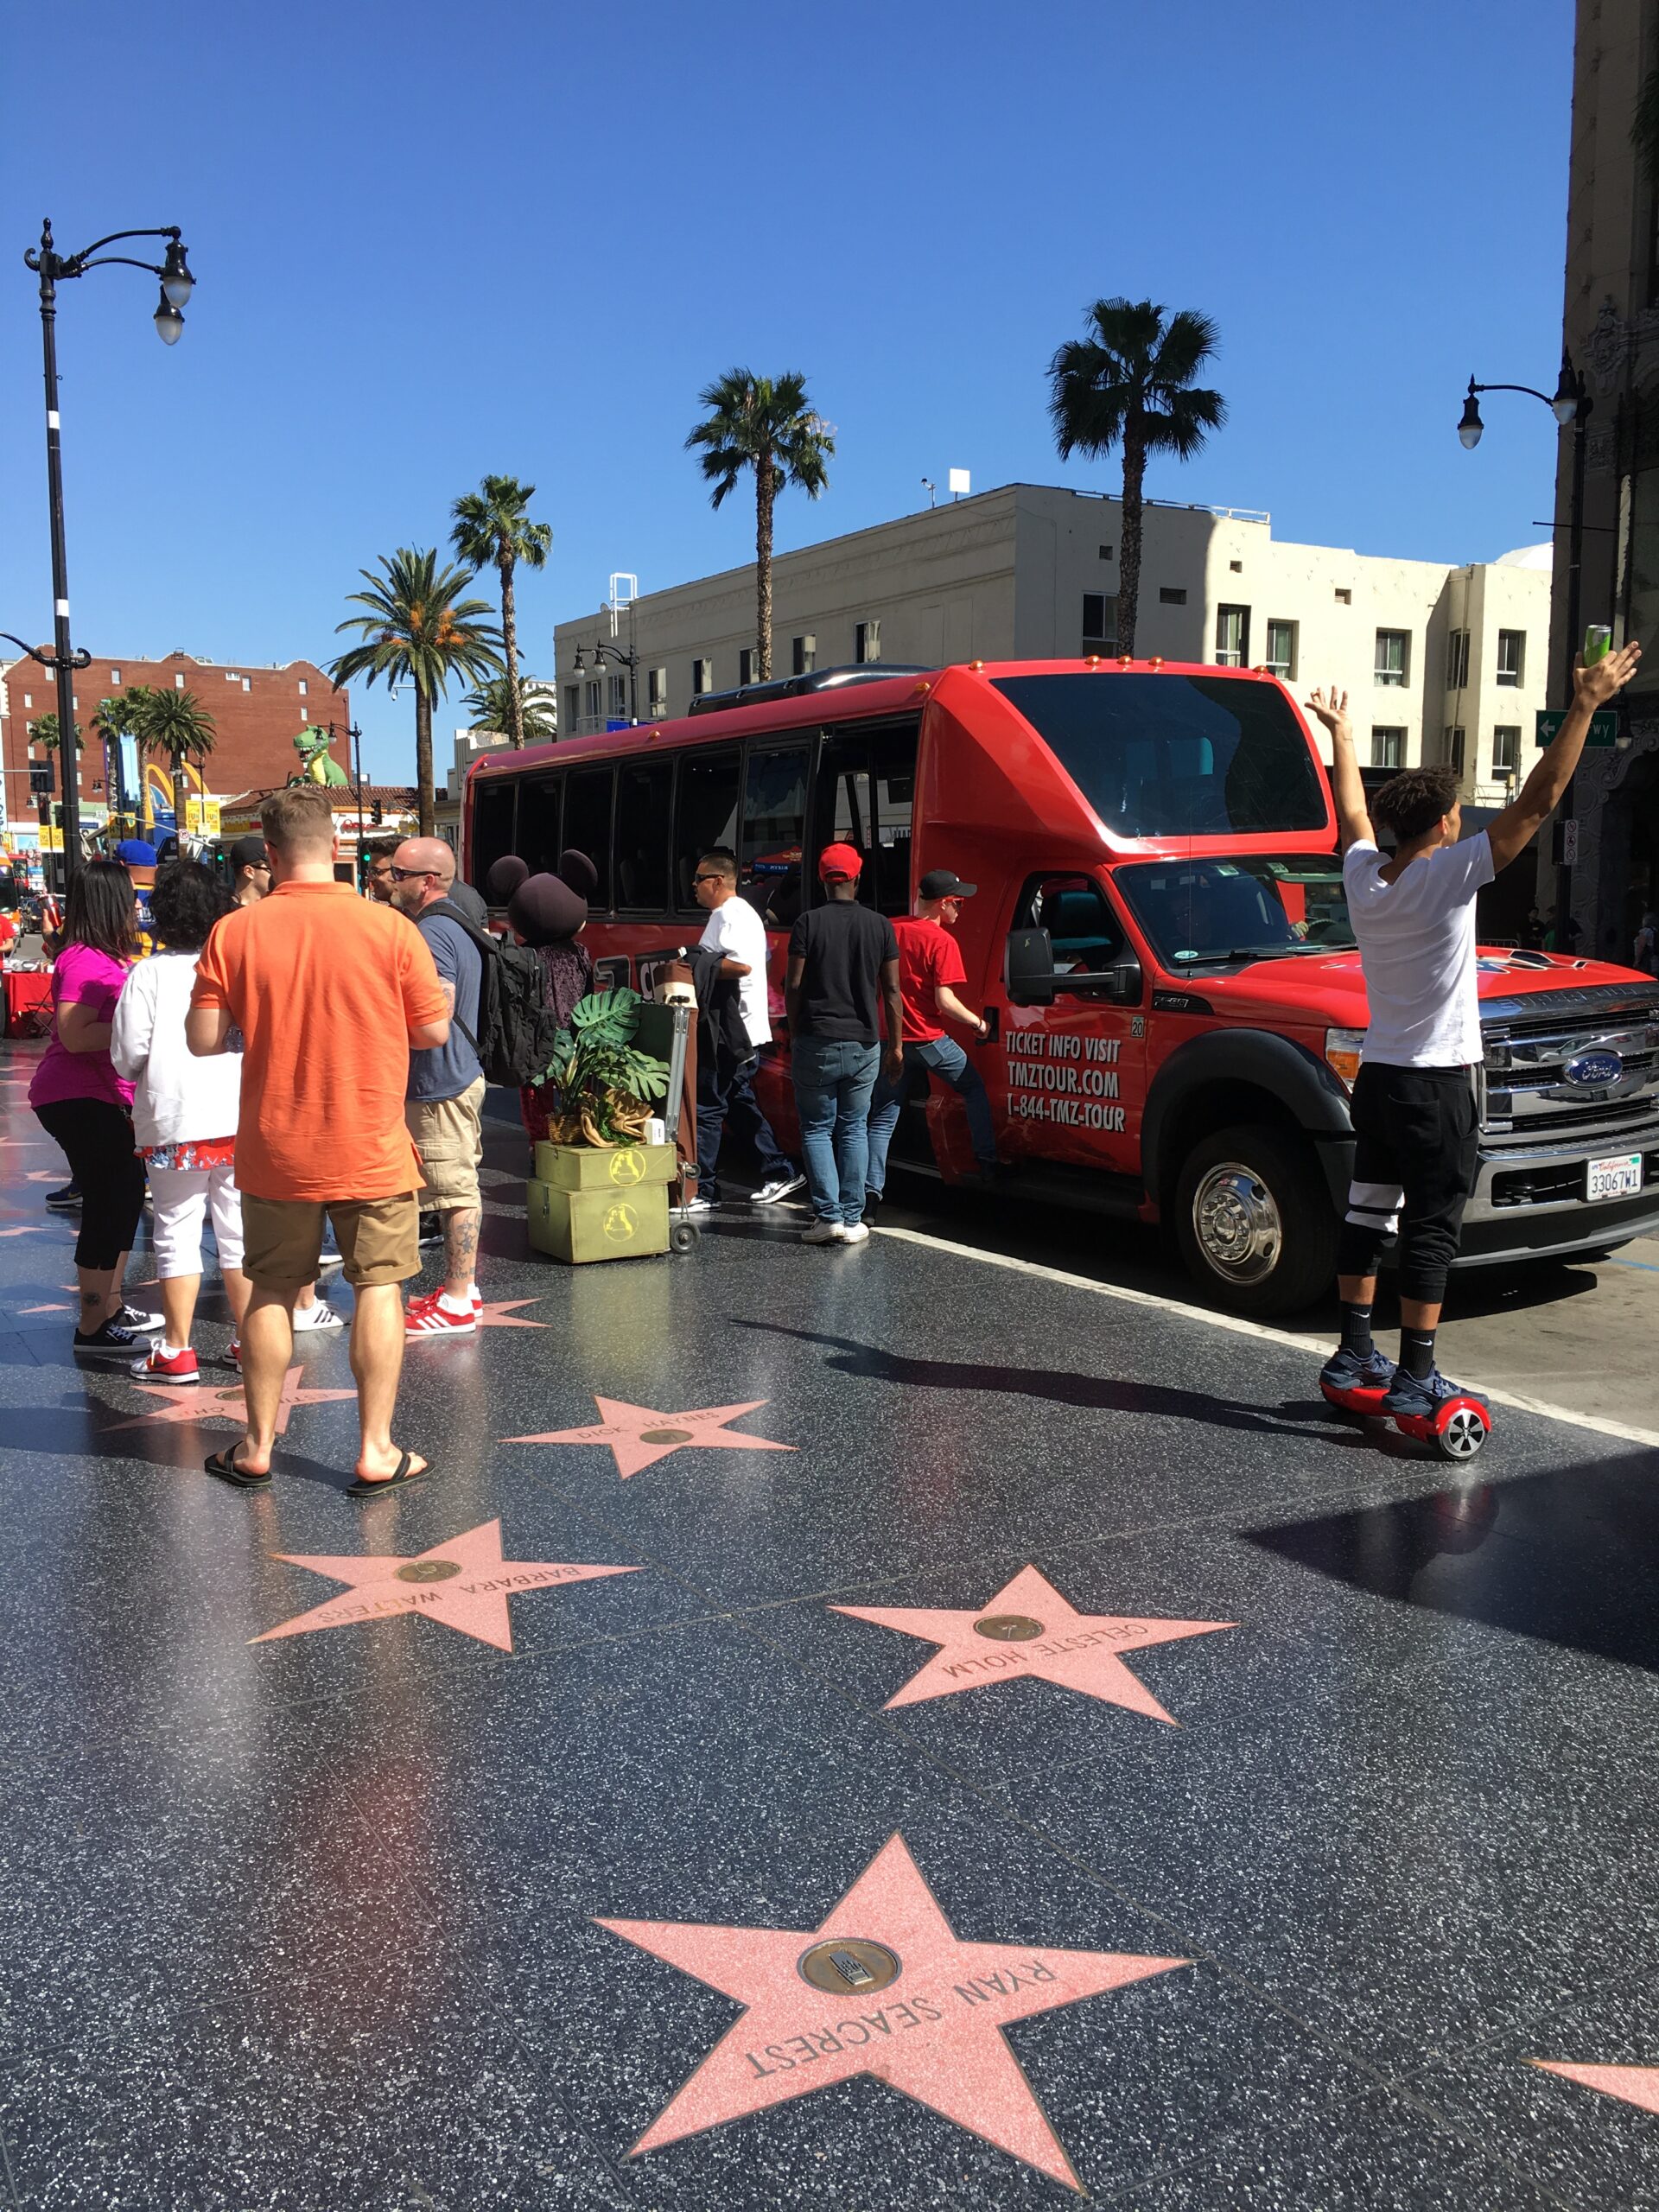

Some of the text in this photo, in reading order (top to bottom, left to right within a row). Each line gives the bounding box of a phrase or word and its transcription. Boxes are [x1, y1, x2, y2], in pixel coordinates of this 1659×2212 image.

[1132, 1021, 1143, 1036] 20
[1005, 1031, 1121, 1063] TICKET INFO VISIT
[1007, 1060, 1119, 1098] TMZTOUR.COM
[1582, 1060, 1613, 1080] Ford
[1007, 1092, 1125, 1132] 1-844-TMZ-TOUR
[1592, 1169, 1637, 1193] 33067W1
[576, 1412, 720, 1440] DICK HAYNES
[318, 1567, 582, 1624] BARBARA WALTERS
[942, 1624, 1148, 1679] CELESTE HOLM
[745, 1960, 1058, 2080] RYAN SEACREST
